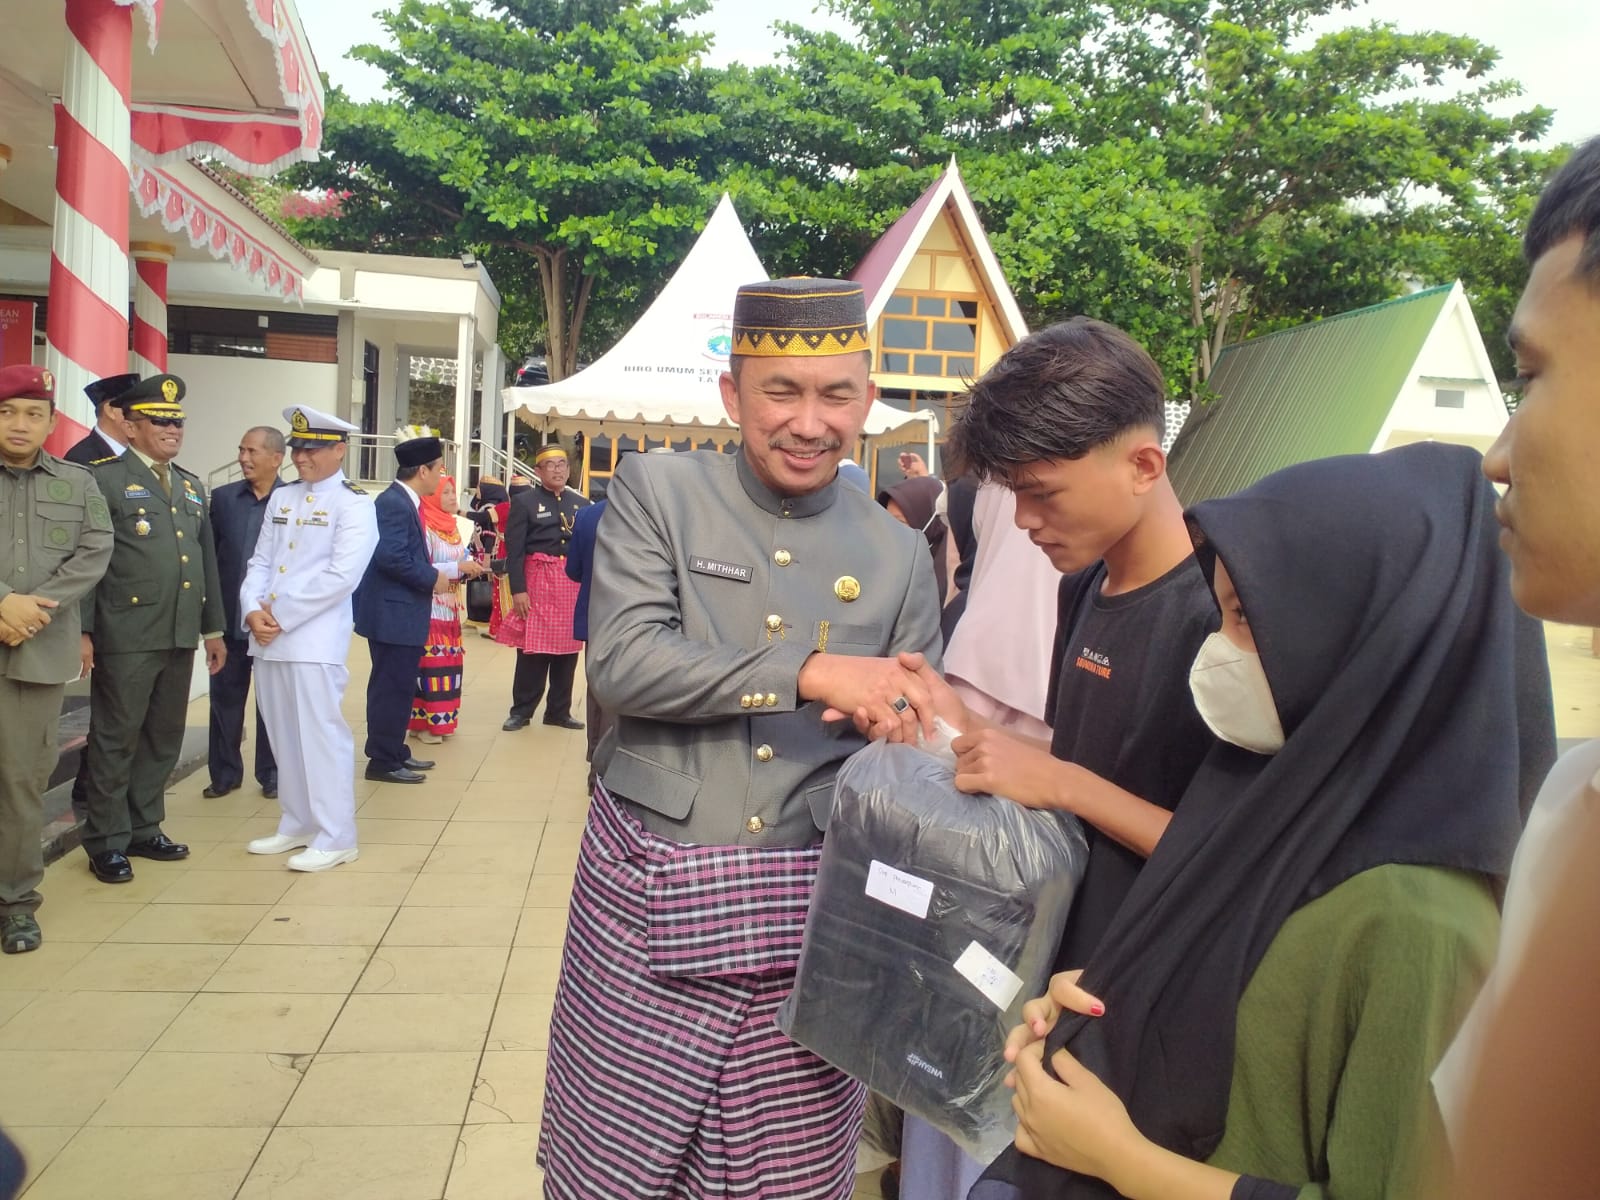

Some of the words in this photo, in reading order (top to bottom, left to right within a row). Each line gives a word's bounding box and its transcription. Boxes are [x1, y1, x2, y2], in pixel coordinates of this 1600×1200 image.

[624, 365, 652, 373] BIRO
[657, 366, 695, 375] UMUM
[696, 560, 706, 569] H.
[707, 561, 746, 577] MITHHAR
